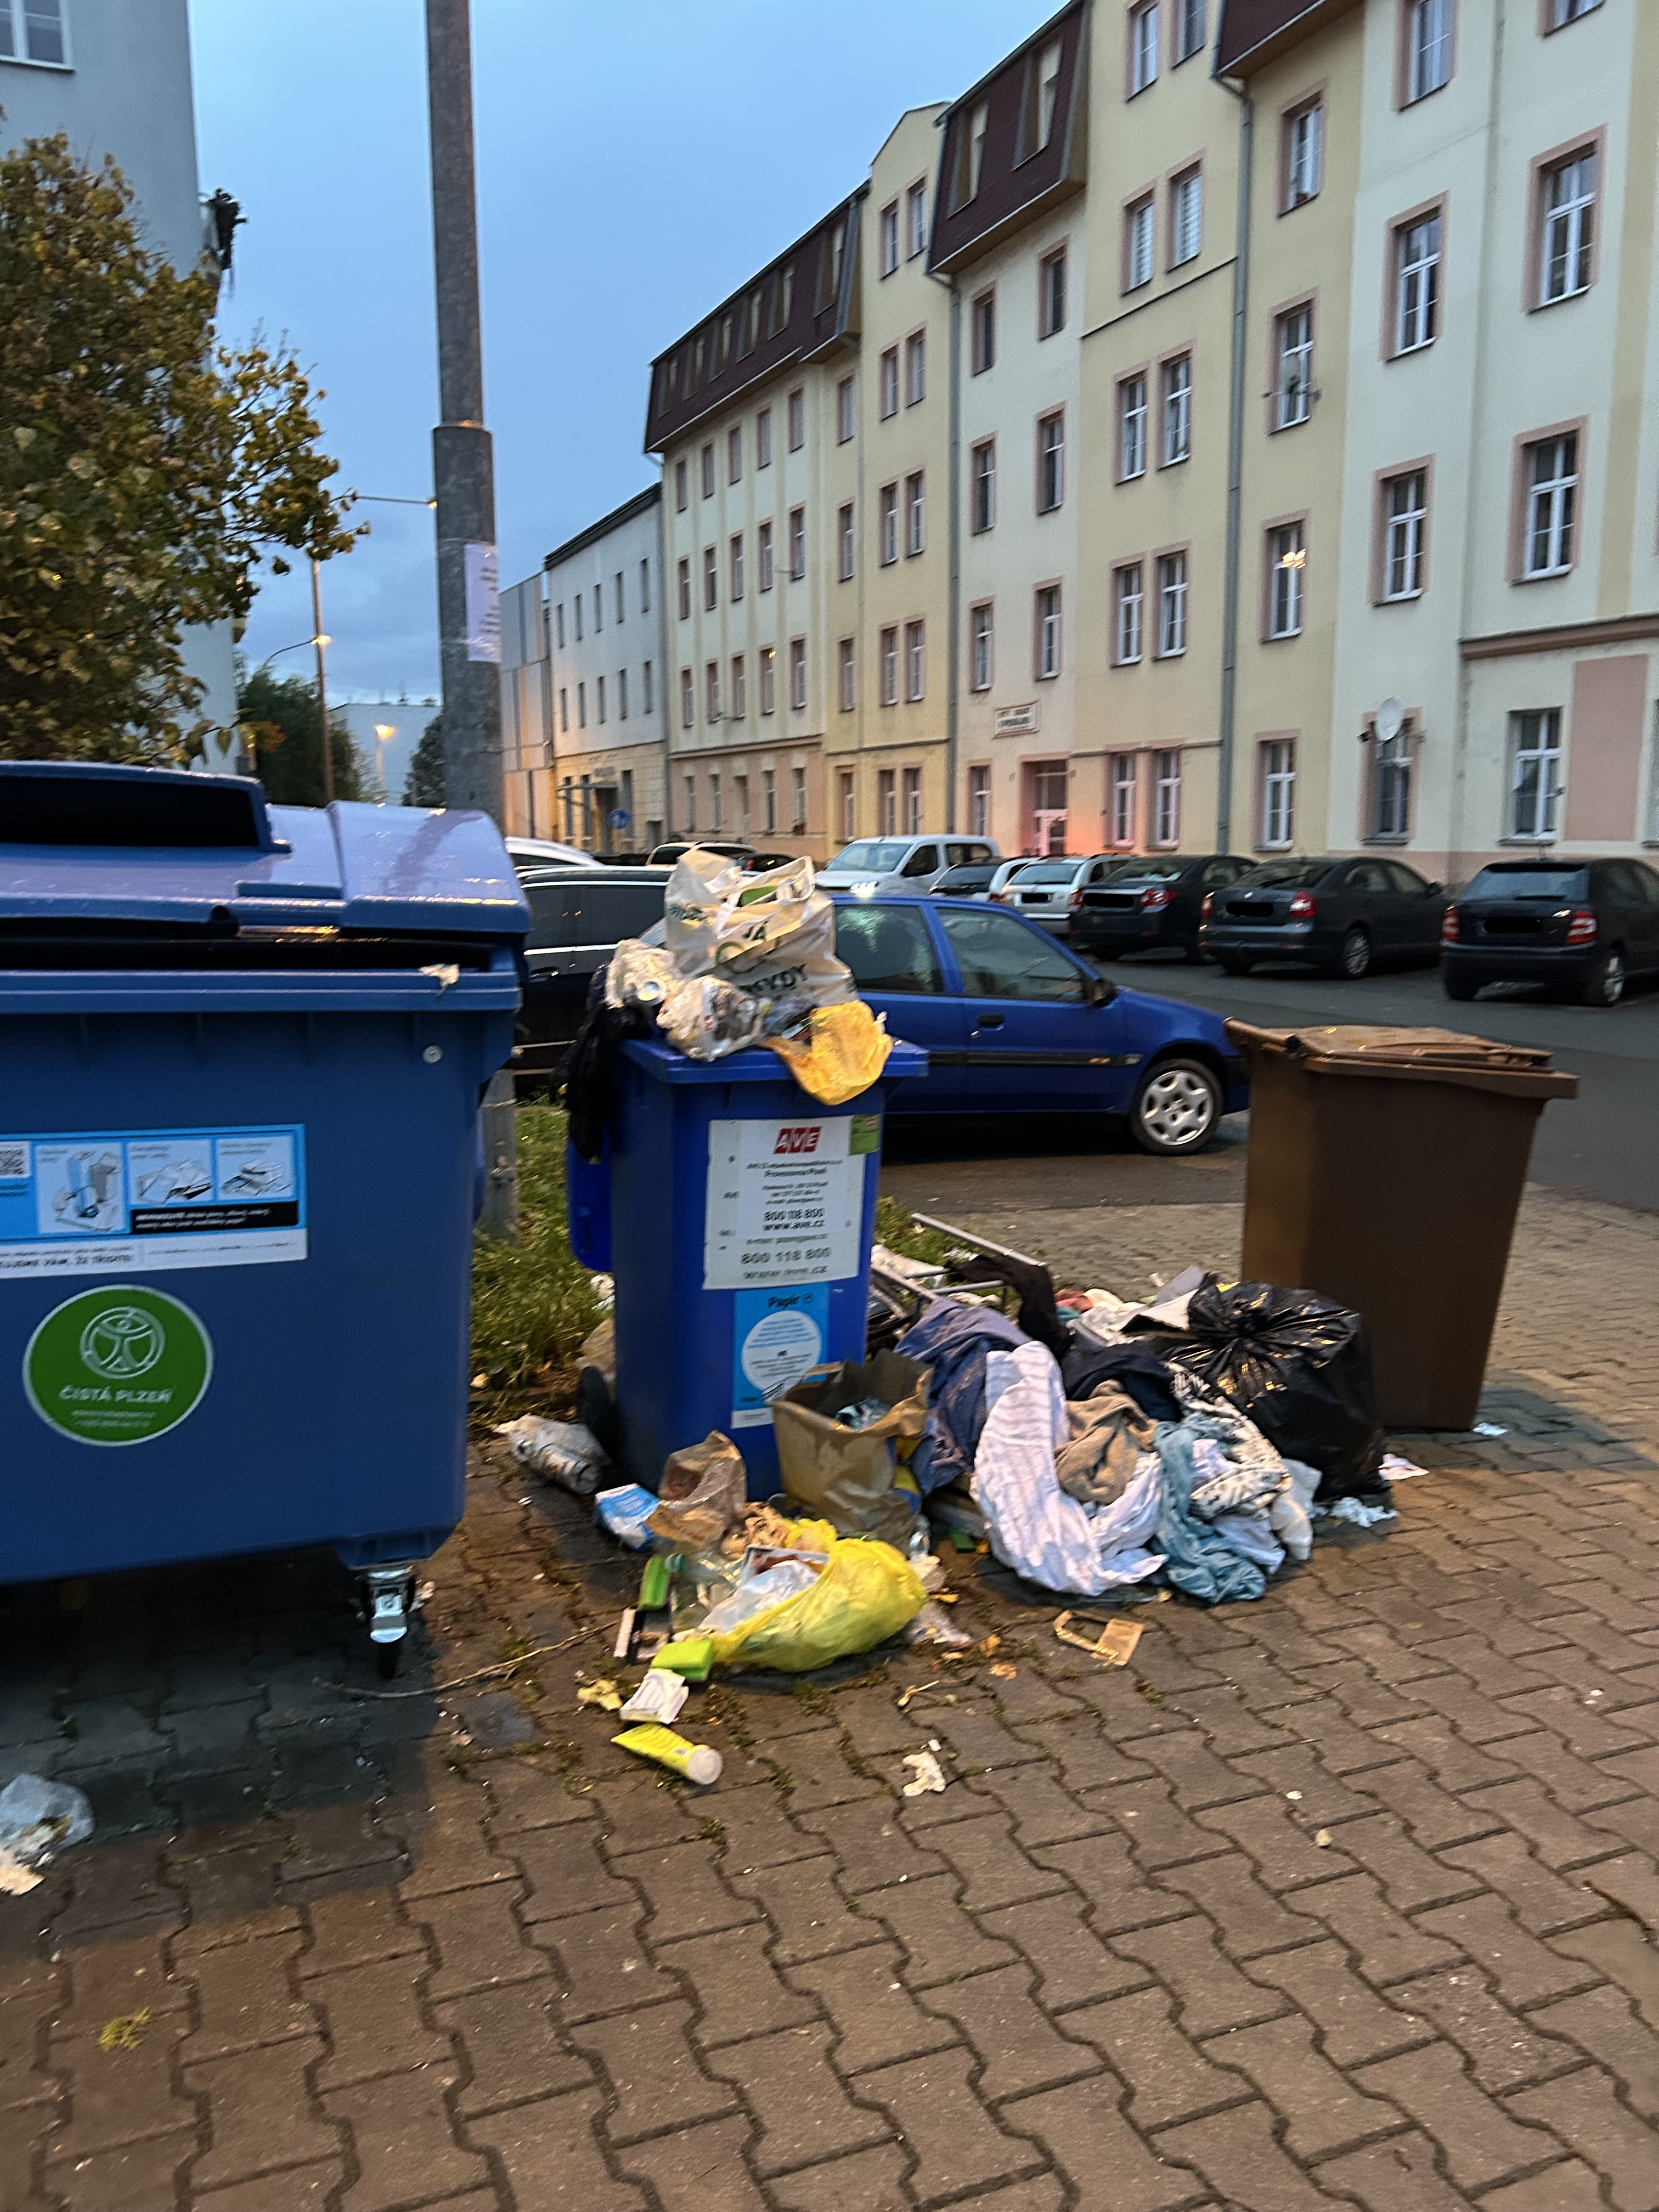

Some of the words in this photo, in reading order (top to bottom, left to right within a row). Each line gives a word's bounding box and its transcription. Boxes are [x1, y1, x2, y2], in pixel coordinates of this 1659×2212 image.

[774, 1130, 820, 1152] AVE
[741, 1252, 771, 1264] 800
[775, 1250, 802, 1262] 118
[805, 1247, 832, 1260] 800
[59, 1384, 111, 1401] ČISTÁ
